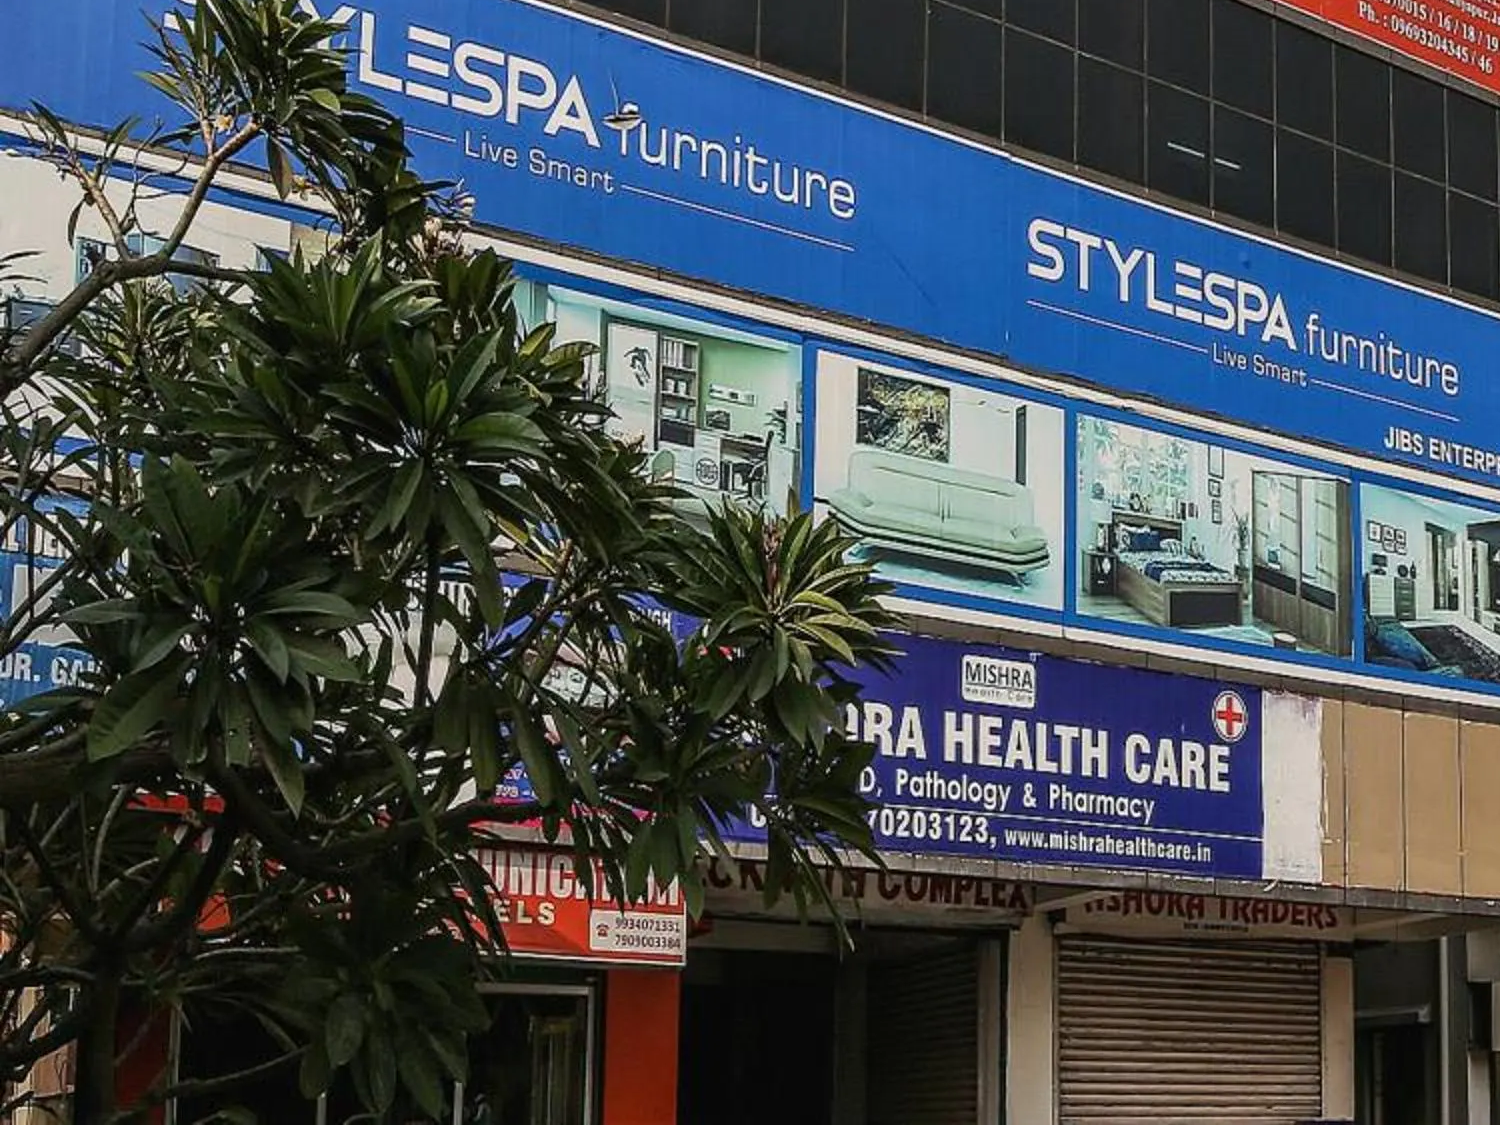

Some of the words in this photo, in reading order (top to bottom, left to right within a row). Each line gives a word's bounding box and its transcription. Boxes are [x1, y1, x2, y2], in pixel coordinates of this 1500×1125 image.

[1358, 0, 1380, 24] Ph.
[462, 133, 518, 170] Live
[528, 148, 615, 195] Smart
[604, 103, 858, 219] furniture
[1026, 216, 1299, 353] STYLESPA
[1304, 313, 1460, 397] furniture
[1212, 341, 1247, 370] Live
[1252, 355, 1308, 388] Smart
[1383, 426, 1423, 456] JIBS
[965, 660, 1033, 689] MISHRA
[944, 710, 1110, 779] HEALTH
[1124, 733, 1231, 793] CARE
[894, 768, 1012, 812] Pathology
[1022, 781, 1037, 808] &
[1049, 783, 1156, 826] Pharmacy
[1004, 826, 1213, 863] www.mishrahealthcare.in
[1218, 894, 1339, 929] TRADERS
